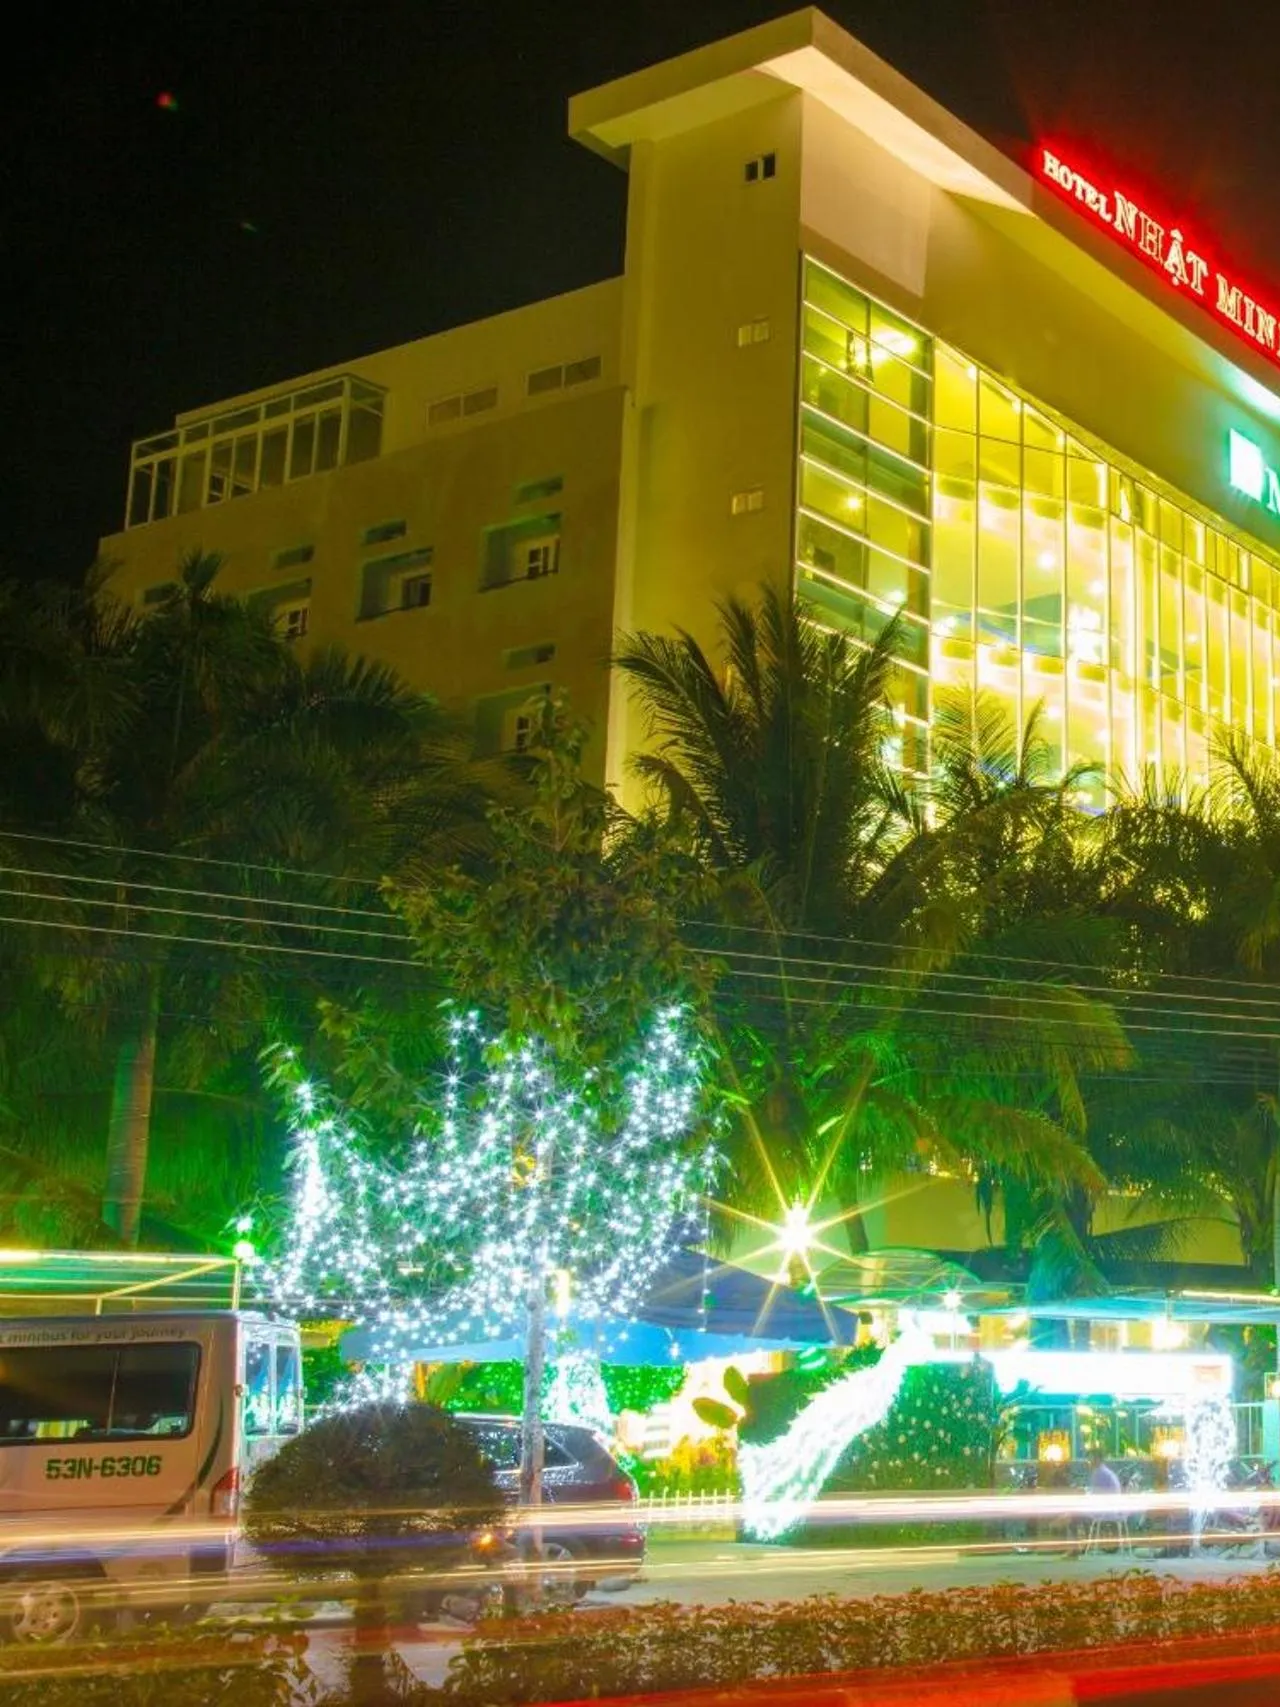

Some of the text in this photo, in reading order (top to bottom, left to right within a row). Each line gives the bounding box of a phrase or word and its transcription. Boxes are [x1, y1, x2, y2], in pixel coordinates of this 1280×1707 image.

[1043, 150, 1112, 223] HOTEL
[1113, 190, 1209, 295] NHẬT
[46, 1455, 163, 1480] 53N-6306
